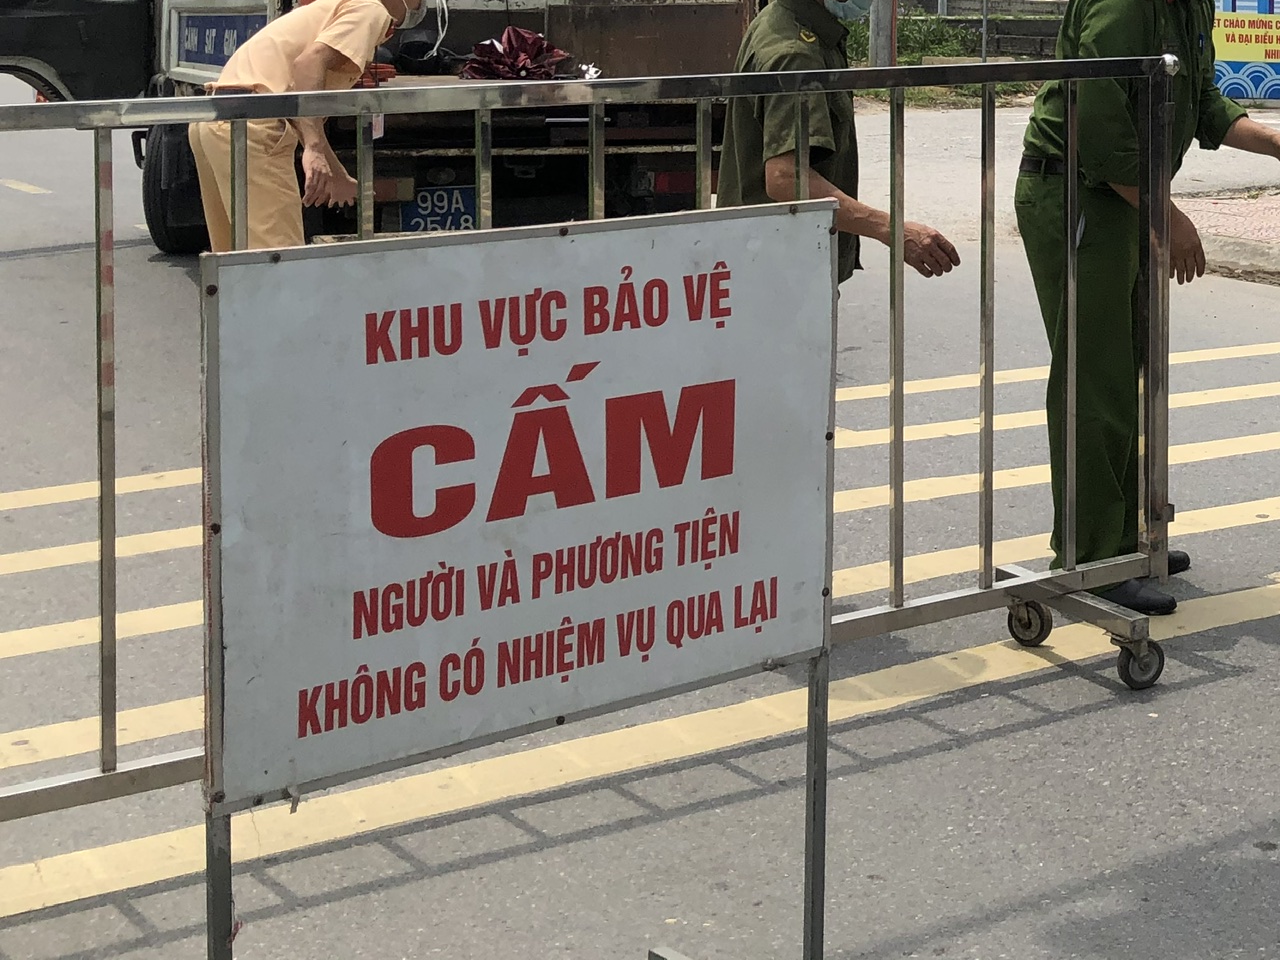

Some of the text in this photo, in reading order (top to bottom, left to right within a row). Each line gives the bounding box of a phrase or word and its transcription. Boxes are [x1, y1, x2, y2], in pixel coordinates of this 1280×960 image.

[1223, 18, 1246, 29] CHÀO
[1248, 17, 1273, 30] MỪNG
[1225, 33, 1237, 43] VÀ
[1238, 33, 1252, 46] ĐẠI
[417, 189, 465, 216] 99A
[365, 260, 733, 366] KHU VỰC BẢO VỆ
[369, 359, 737, 540] CẤM
[352, 507, 742, 640] NGƯỜI VÀ PHƯƠNG TIỆN
[296, 576, 780, 739] KHÔNG CÓ NHIỆM VỤ QUA LẠI
